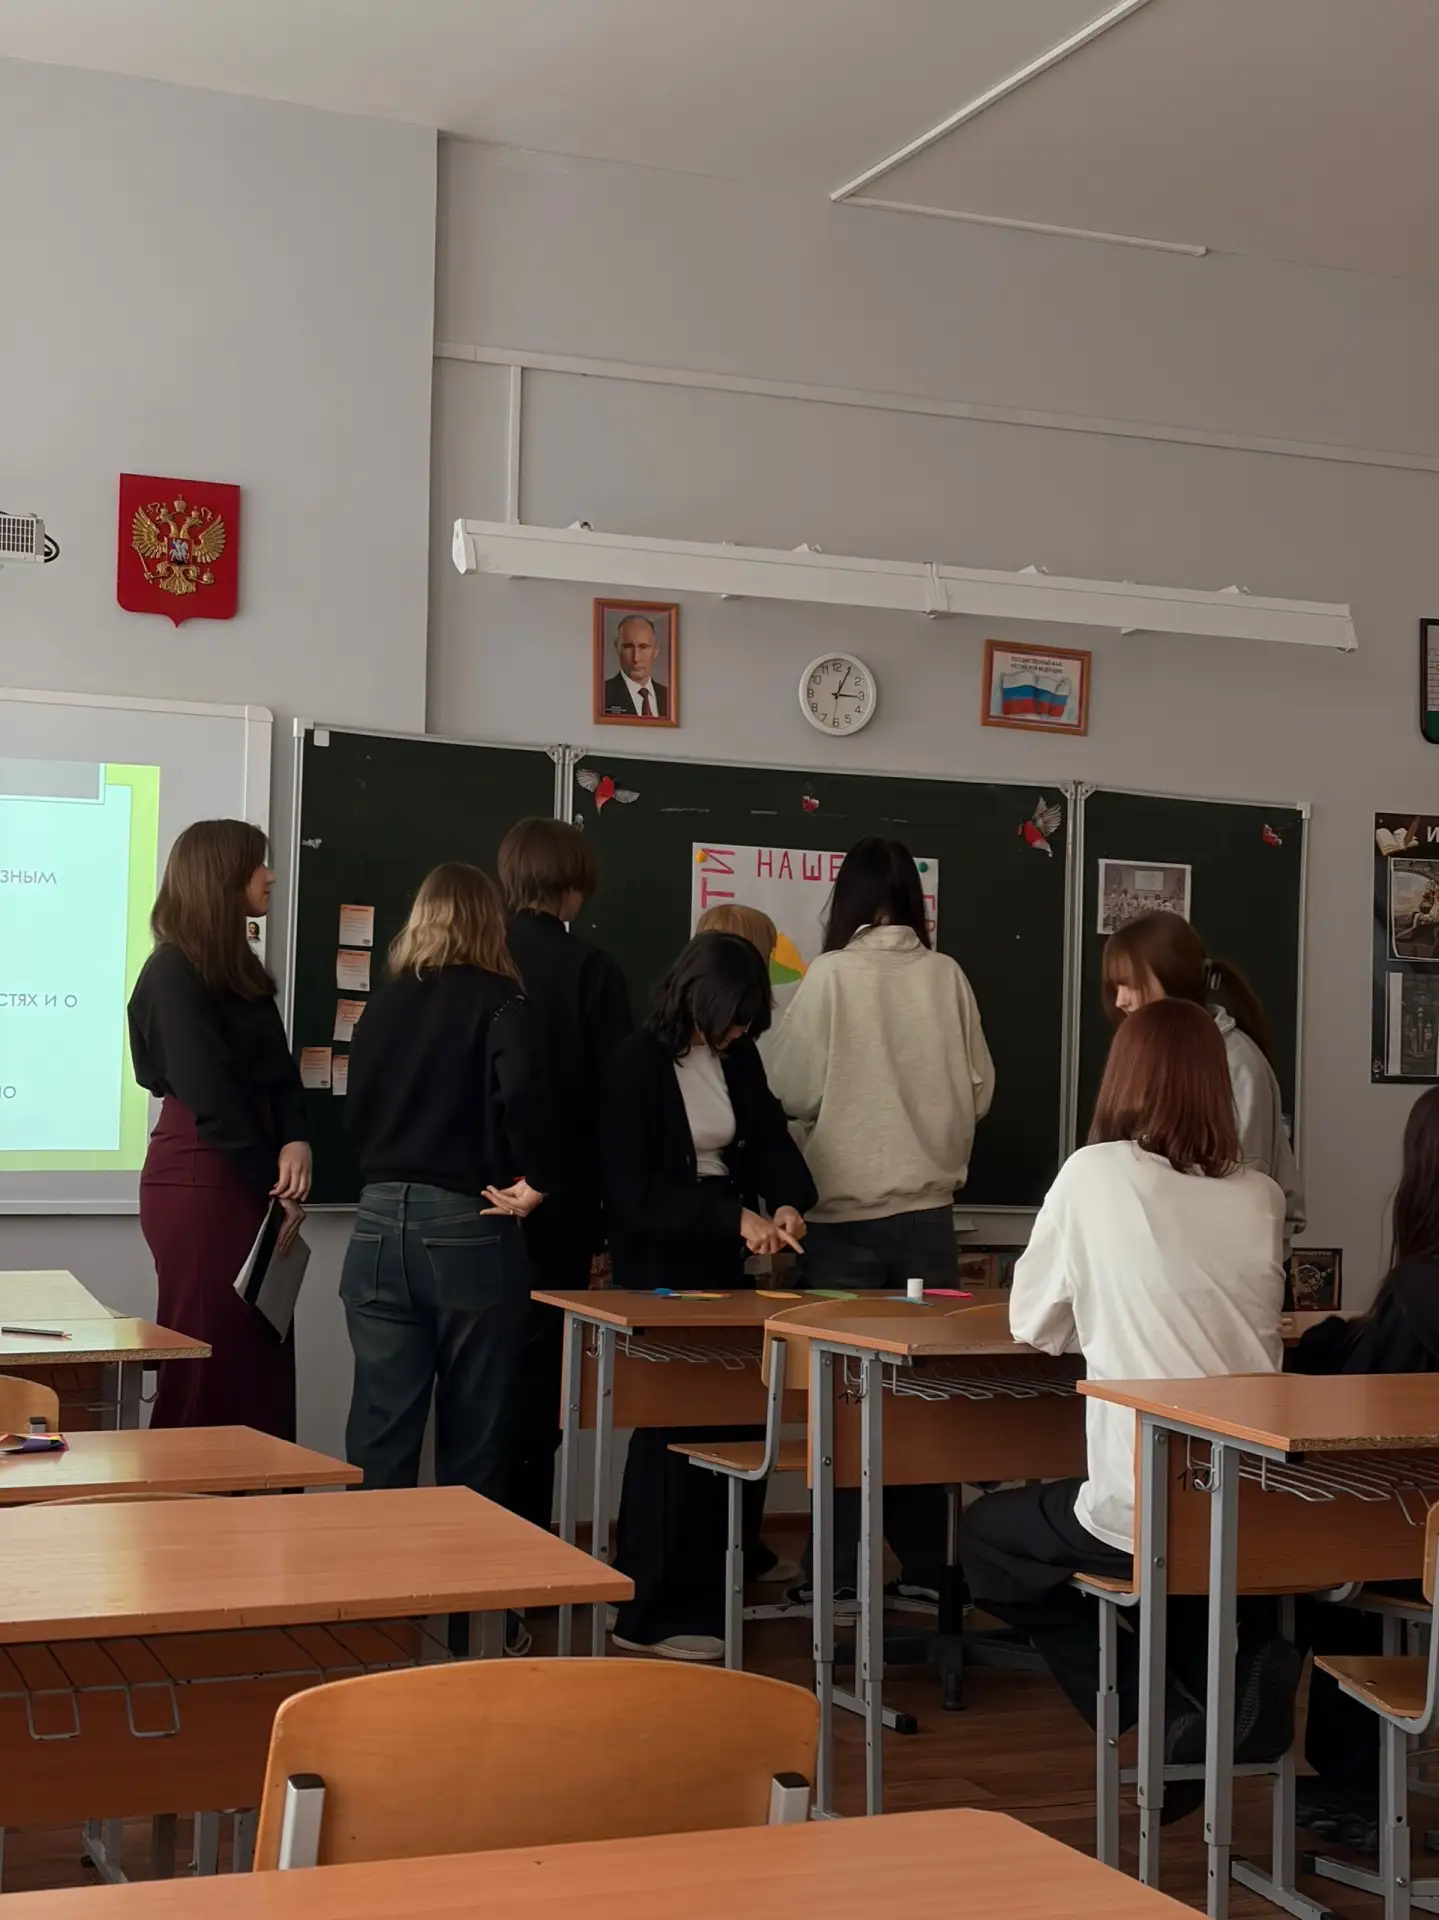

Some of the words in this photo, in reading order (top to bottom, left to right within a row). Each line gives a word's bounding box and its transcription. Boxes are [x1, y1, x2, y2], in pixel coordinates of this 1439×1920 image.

[821, 665, 829, 675] 11
[831, 662, 842, 673] 12
[811, 674, 822, 685] 10
[854, 676, 862, 687] 2
[807, 688, 815, 699] 9
[858, 690, 866, 701] 3
[811, 702, 819, 713] 8
[854, 704, 862, 714] 4
[821, 712, 828, 722] 7
[832, 717, 840, 728] 6
[844, 713, 852, 724] 5
[0, 869, 57, 884] ЗНЫМ
[701, 848, 735, 909] ТИ
[0, 993, 38, 1008] СТЯХ
[44, 994, 57, 1008] И
[64, 994, 78, 1008] О
